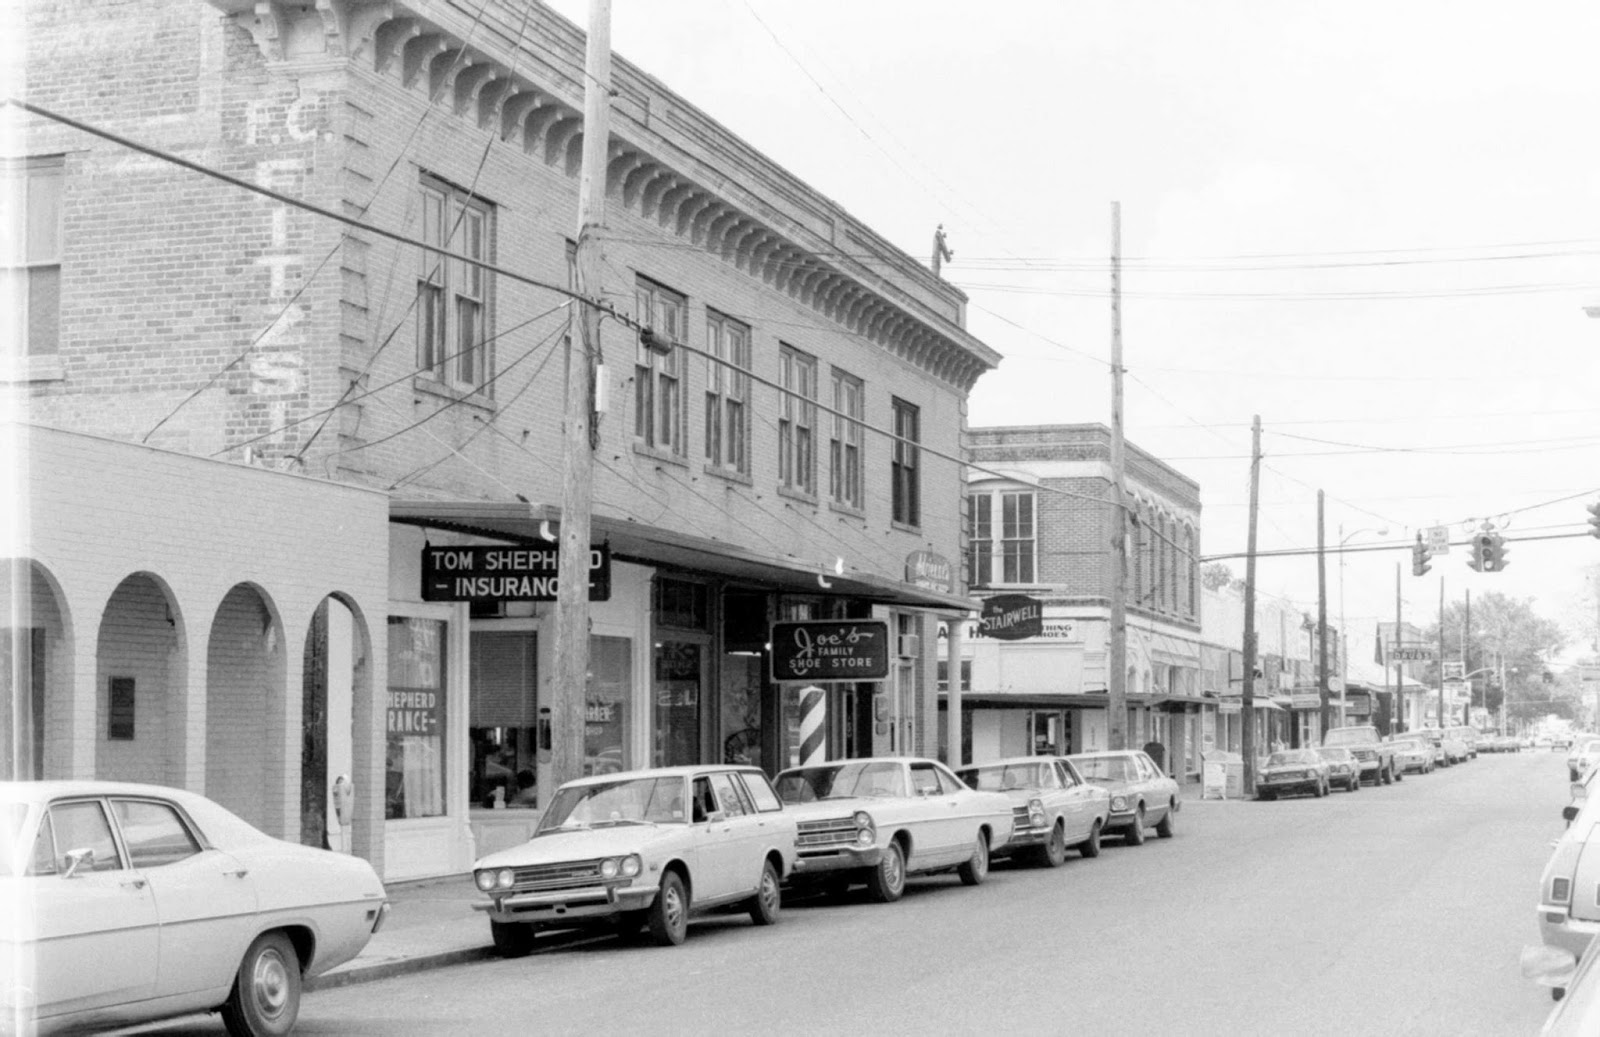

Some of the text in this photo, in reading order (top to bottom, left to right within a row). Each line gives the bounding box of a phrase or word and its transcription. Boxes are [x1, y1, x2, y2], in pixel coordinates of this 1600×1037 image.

[431, 551, 603, 570] TOM SHEPHD
[455, 576, 561, 597] INSURANC
[984, 604, 1040, 631] STAIRWELL
[793, 625, 876, 676] Joe's
[817, 646, 855, 656] FAMILY
[788, 657, 872, 669] SHOE STORE
[386, 691, 436, 709] HEPHERD
